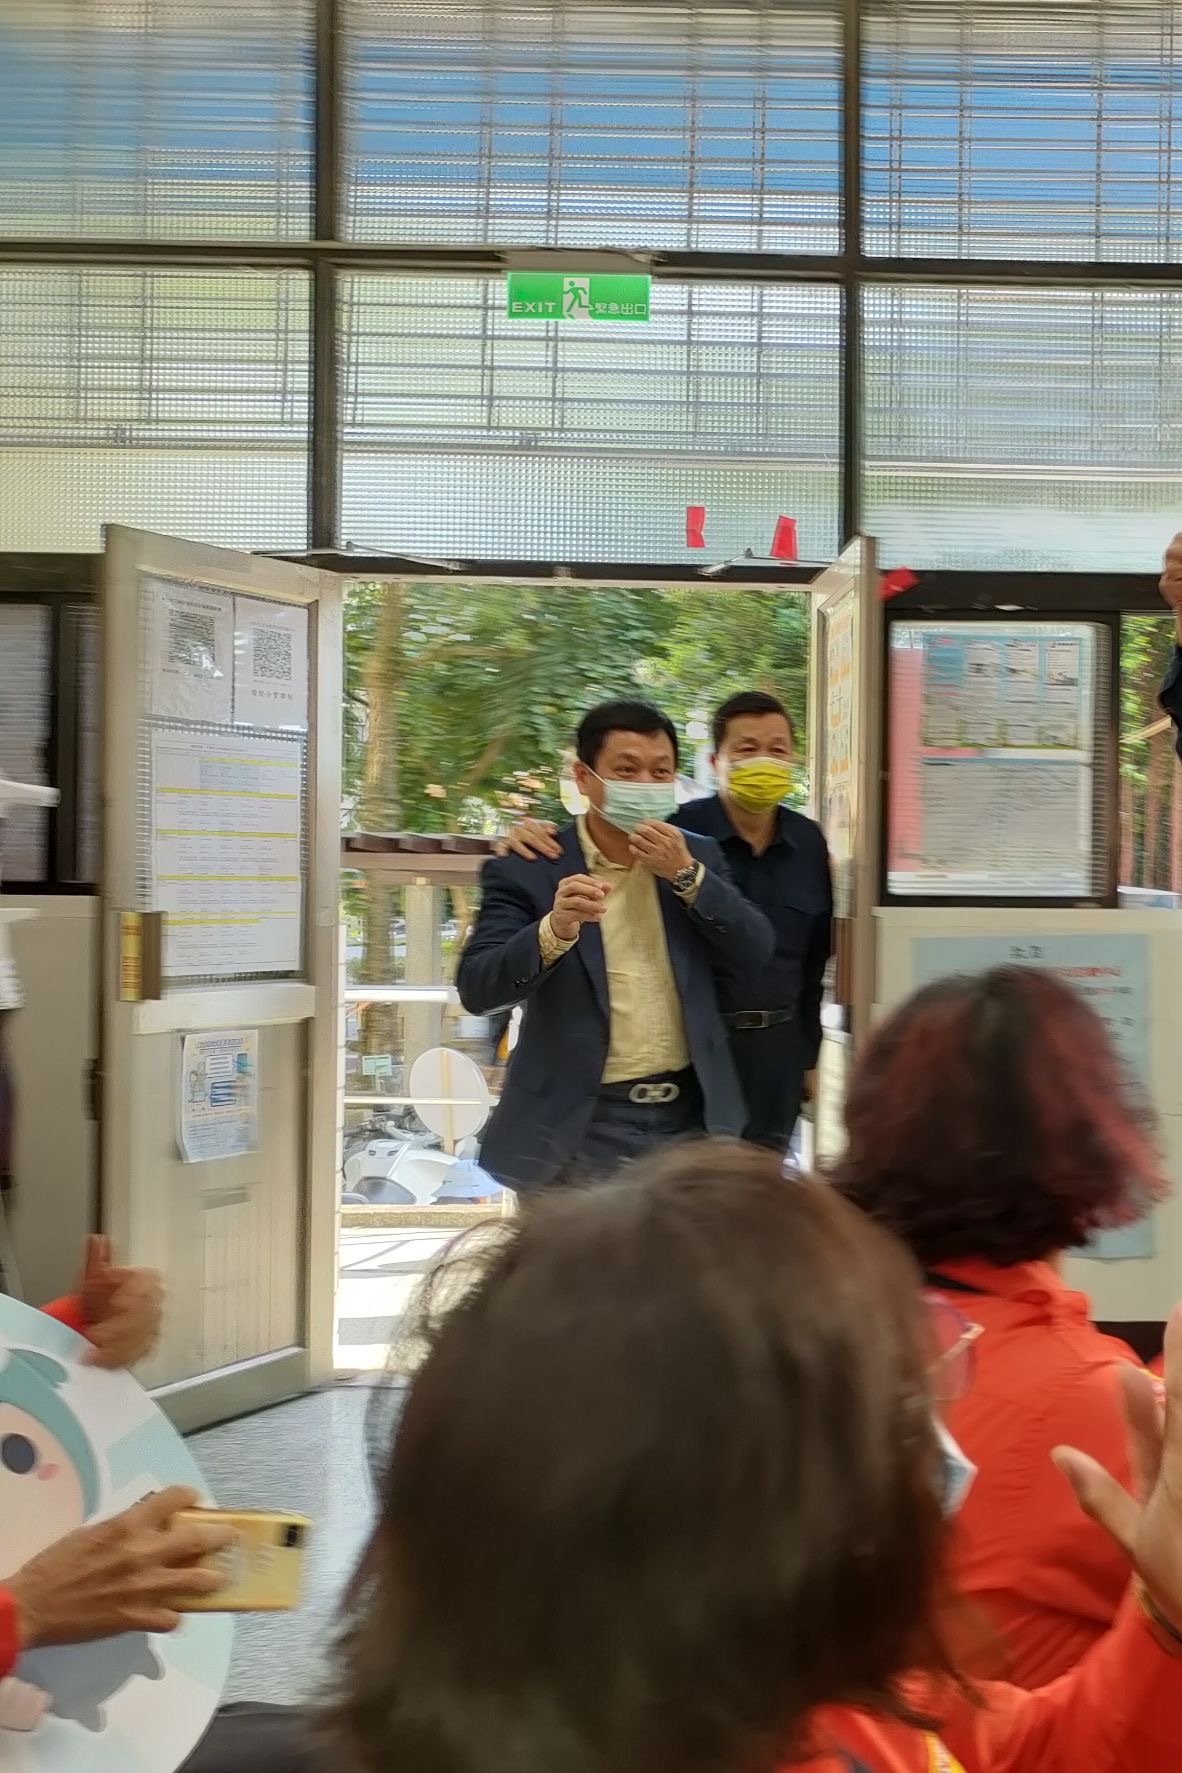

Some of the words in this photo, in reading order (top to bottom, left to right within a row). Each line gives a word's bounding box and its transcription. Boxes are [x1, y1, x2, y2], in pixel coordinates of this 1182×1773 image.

[511, 302, 557, 313] EXIT
[594, 302, 647, 315] 緊急出口
